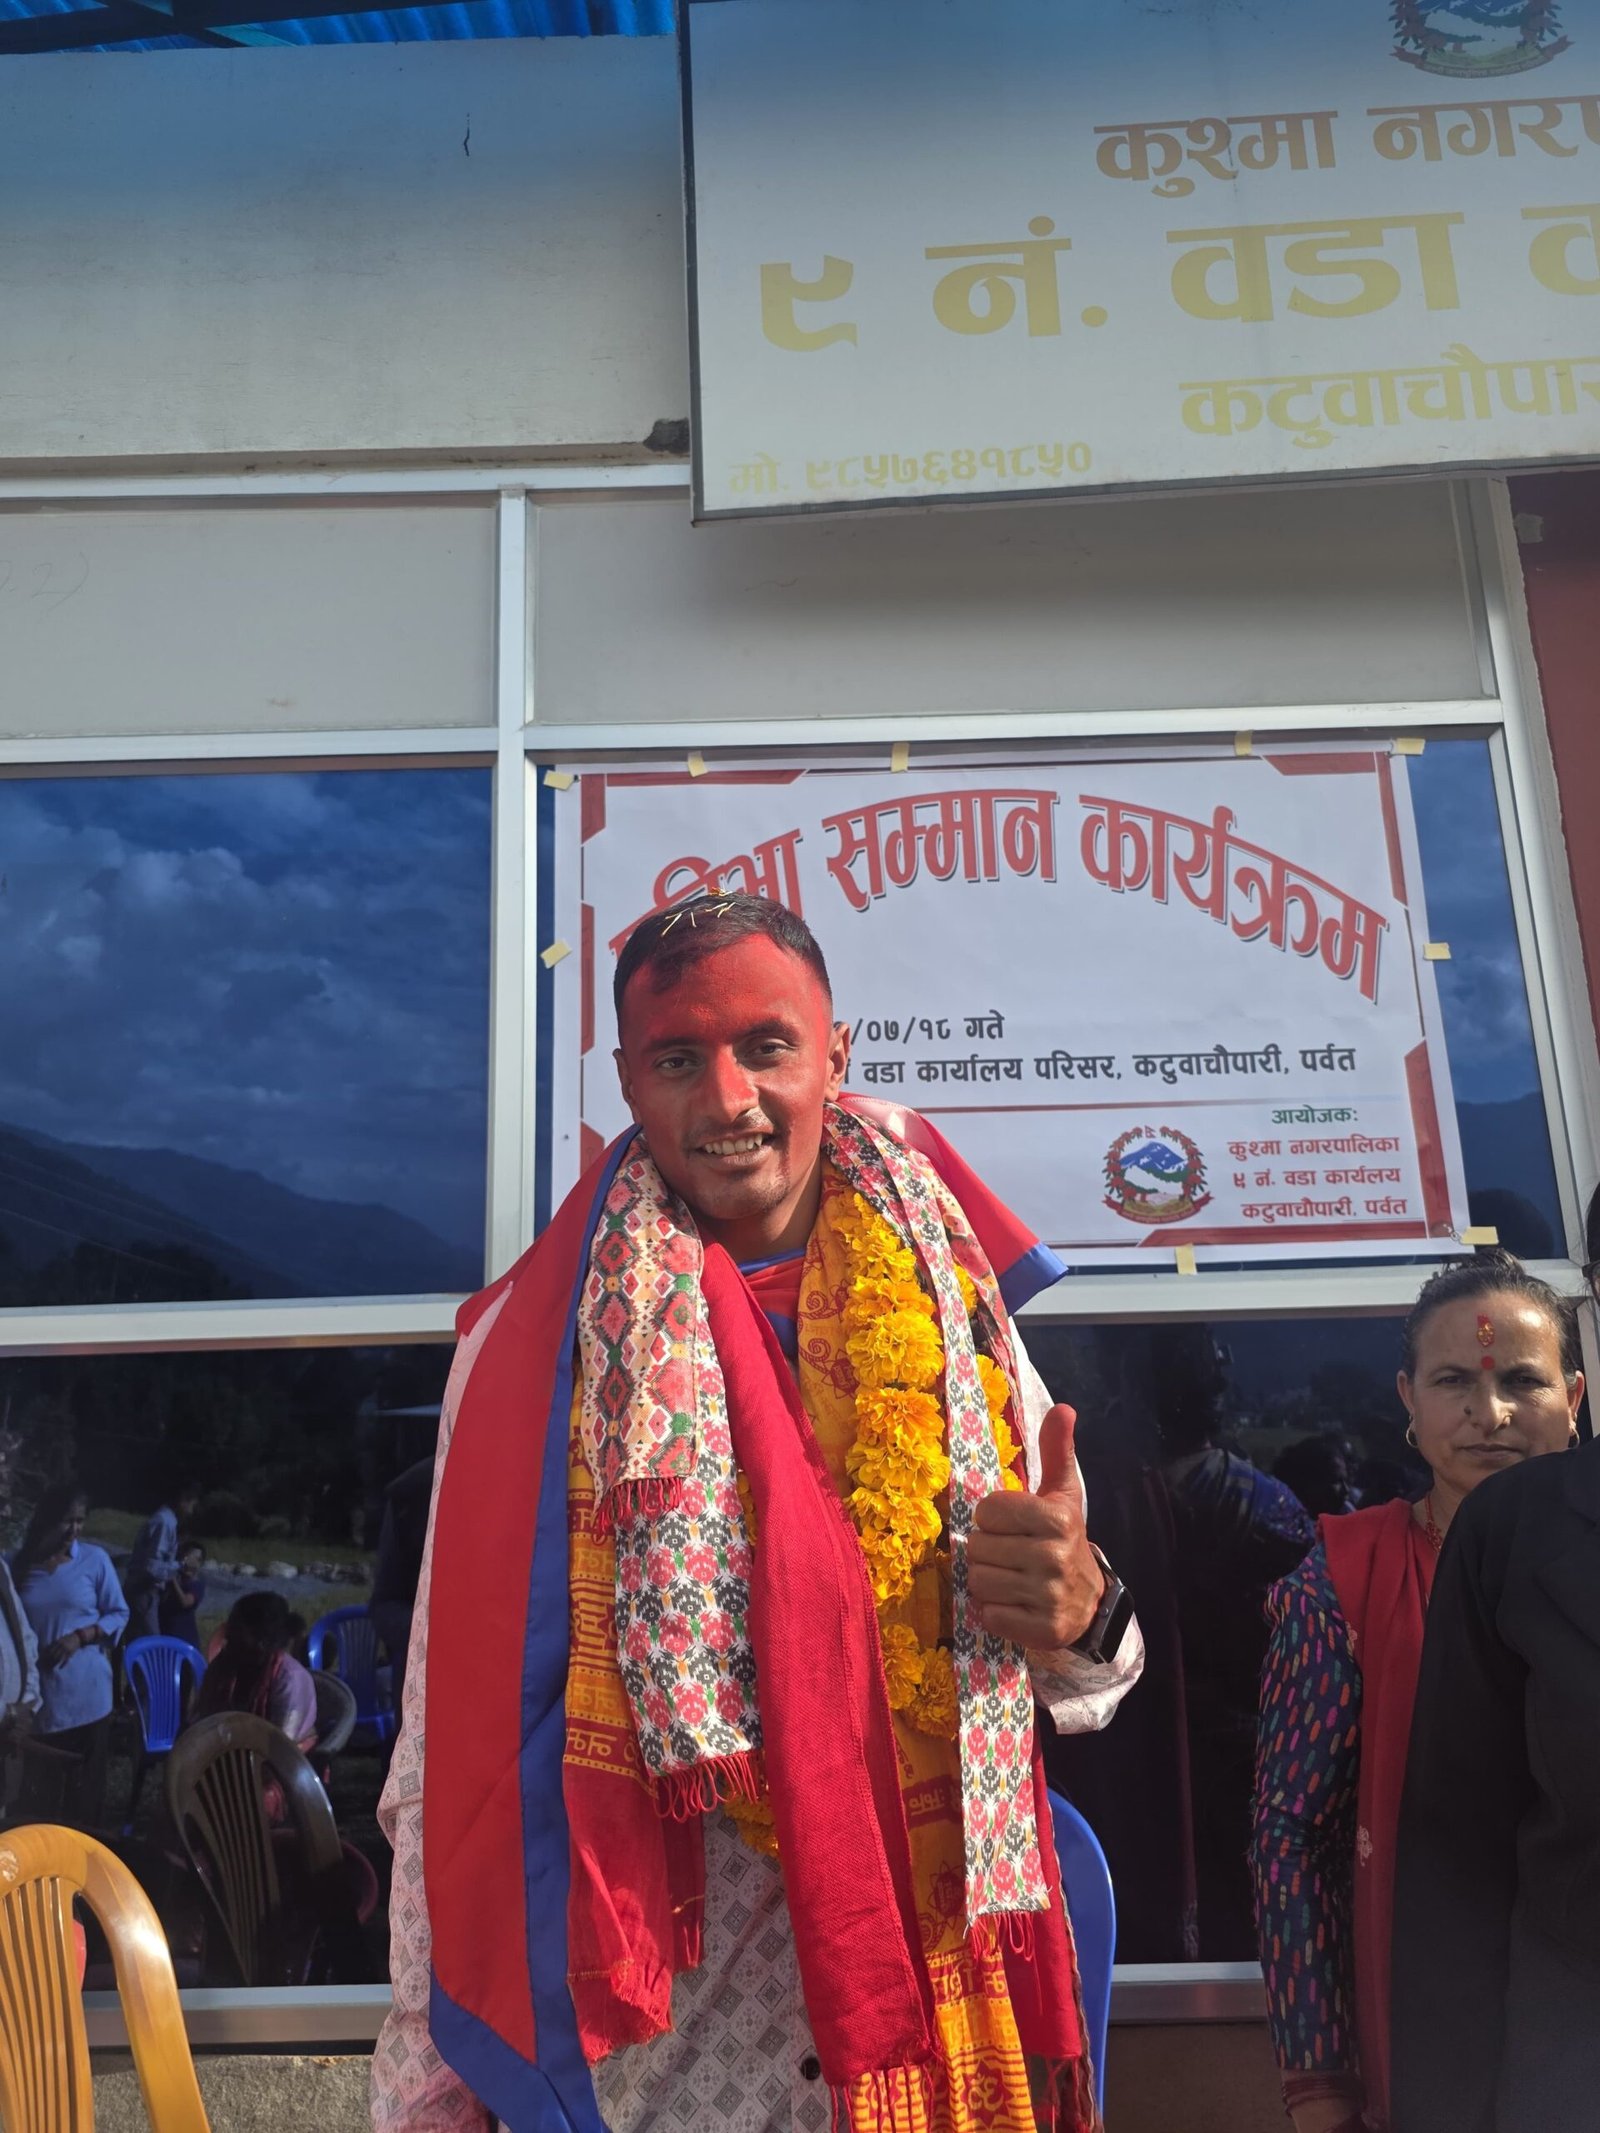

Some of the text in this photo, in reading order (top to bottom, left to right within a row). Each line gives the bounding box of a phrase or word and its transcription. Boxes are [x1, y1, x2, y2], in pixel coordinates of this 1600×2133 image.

[1095, 110, 1339, 199] कुश्मा
[924, 215, 1109, 338] नं.
[1166, 211, 1465, 324] वडा
[822, 788, 1062, 914] सम्मान
[1079, 794, 1391, 1005] कार्यक्रम
[963, 1009, 1005, 1039] गते
[862, 1061, 906, 1084] वडा
[915, 1053, 1024, 1082] कार्यालय
[1033, 1049, 1122, 1080] परिसर,
[1132, 1043, 1289, 1084] कटुवाचौपारी,
[1298, 1043, 1357, 1071] पर्वत
[1227, 1133, 1400, 1161] कुश्मा नगरपालिका
[1283, 1170, 1317, 1186] वडा
[1364, 1196, 1408, 1215] पर्वत
